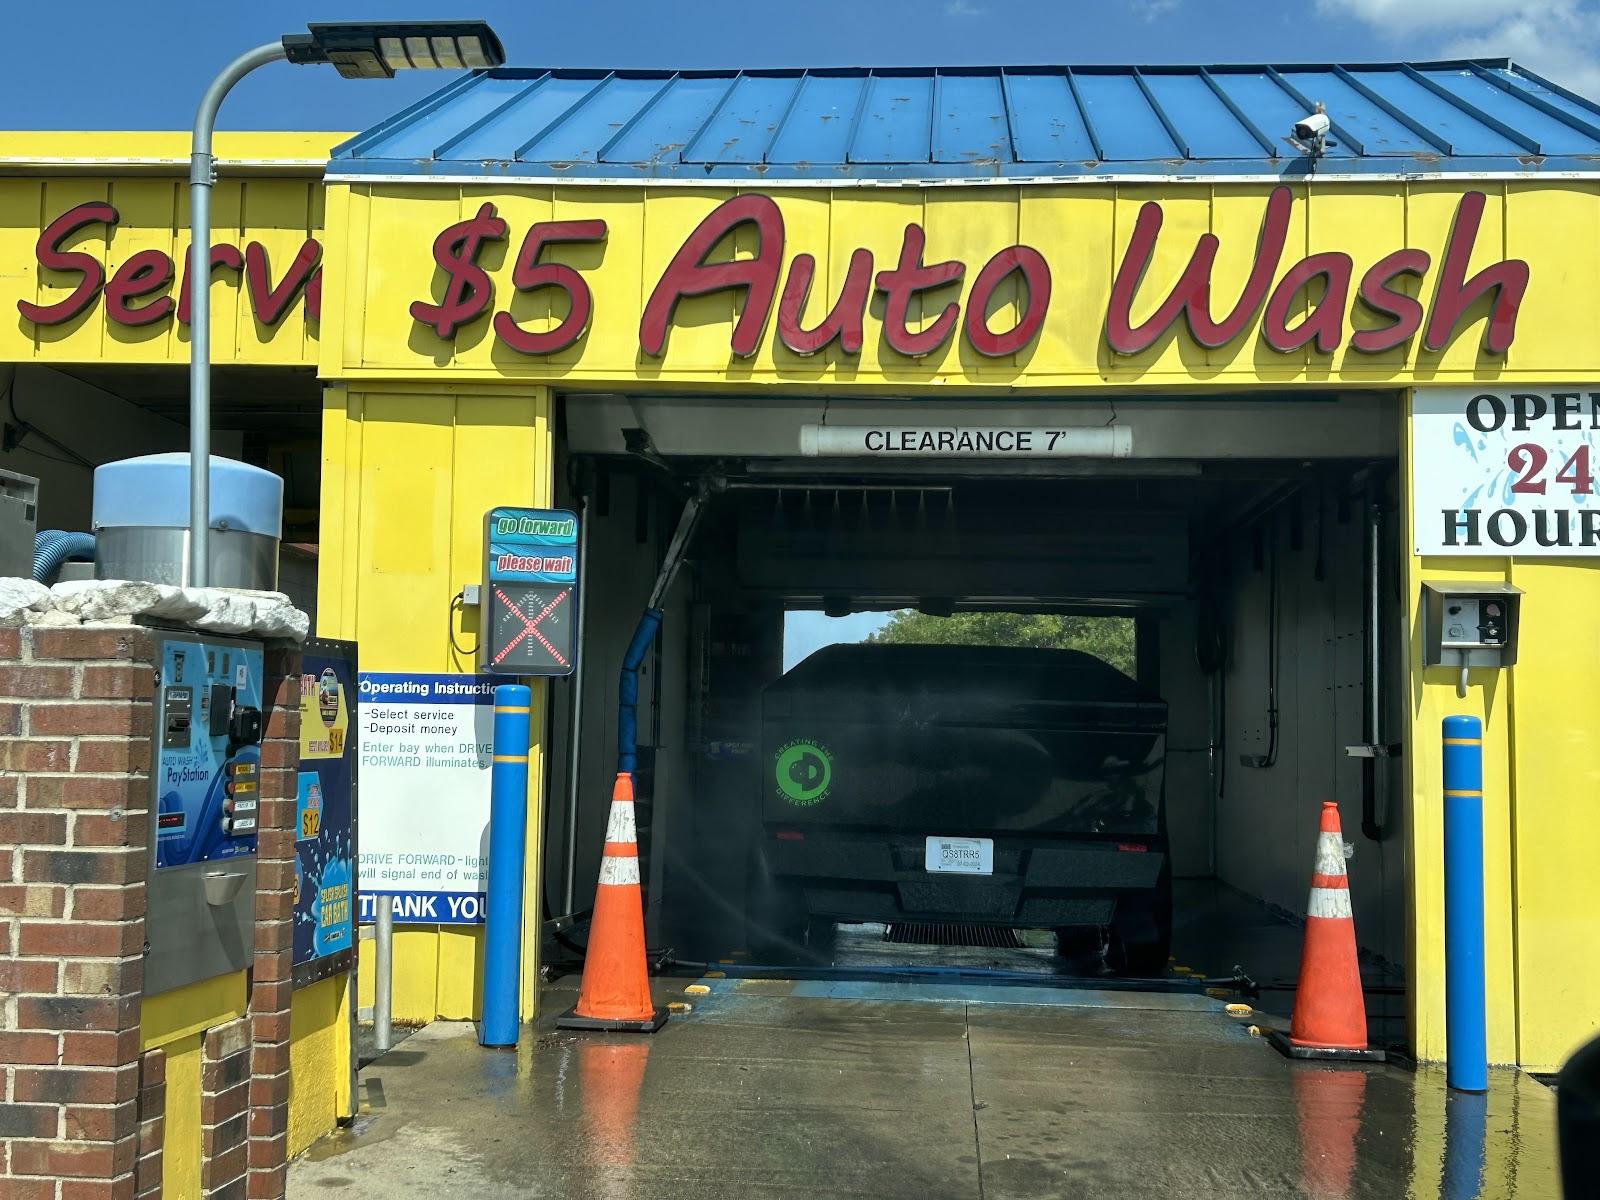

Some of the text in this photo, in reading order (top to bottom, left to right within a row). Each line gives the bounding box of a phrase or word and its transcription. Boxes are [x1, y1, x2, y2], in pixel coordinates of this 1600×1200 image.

[17, 202, 322, 325] Serv
[409, 185, 1530, 358] $5 Auto Wash
[864, 430, 1067, 452] CLEARANCE 7'
[1507, 442, 1595, 495] 24
[498, 517, 574, 537] go forward
[497, 554, 573, 573] please wait
[360, 680, 430, 696] Operating
[413, 710, 455, 721] service
[420, 725, 458, 736] money
[329, 732, 343, 752] $14
[363, 741, 493, 755] Enter bay when DRIVE
[775, 738, 818, 759] CREATING
[162, 756, 193, 766] AUTO WASH
[362, 756, 421, 767] FORWARD
[167, 766, 209, 787] PayStation
[776, 787, 831, 806] DIFFERENCE
[303, 813, 319, 836] $12
[358, 854, 393, 864] DRIVE
[398, 854, 455, 865] FORWARD
[358, 869, 376, 879] will
[381, 869, 415, 881] signal
[421, 869, 441, 879] end
[446, 869, 458, 880] of
